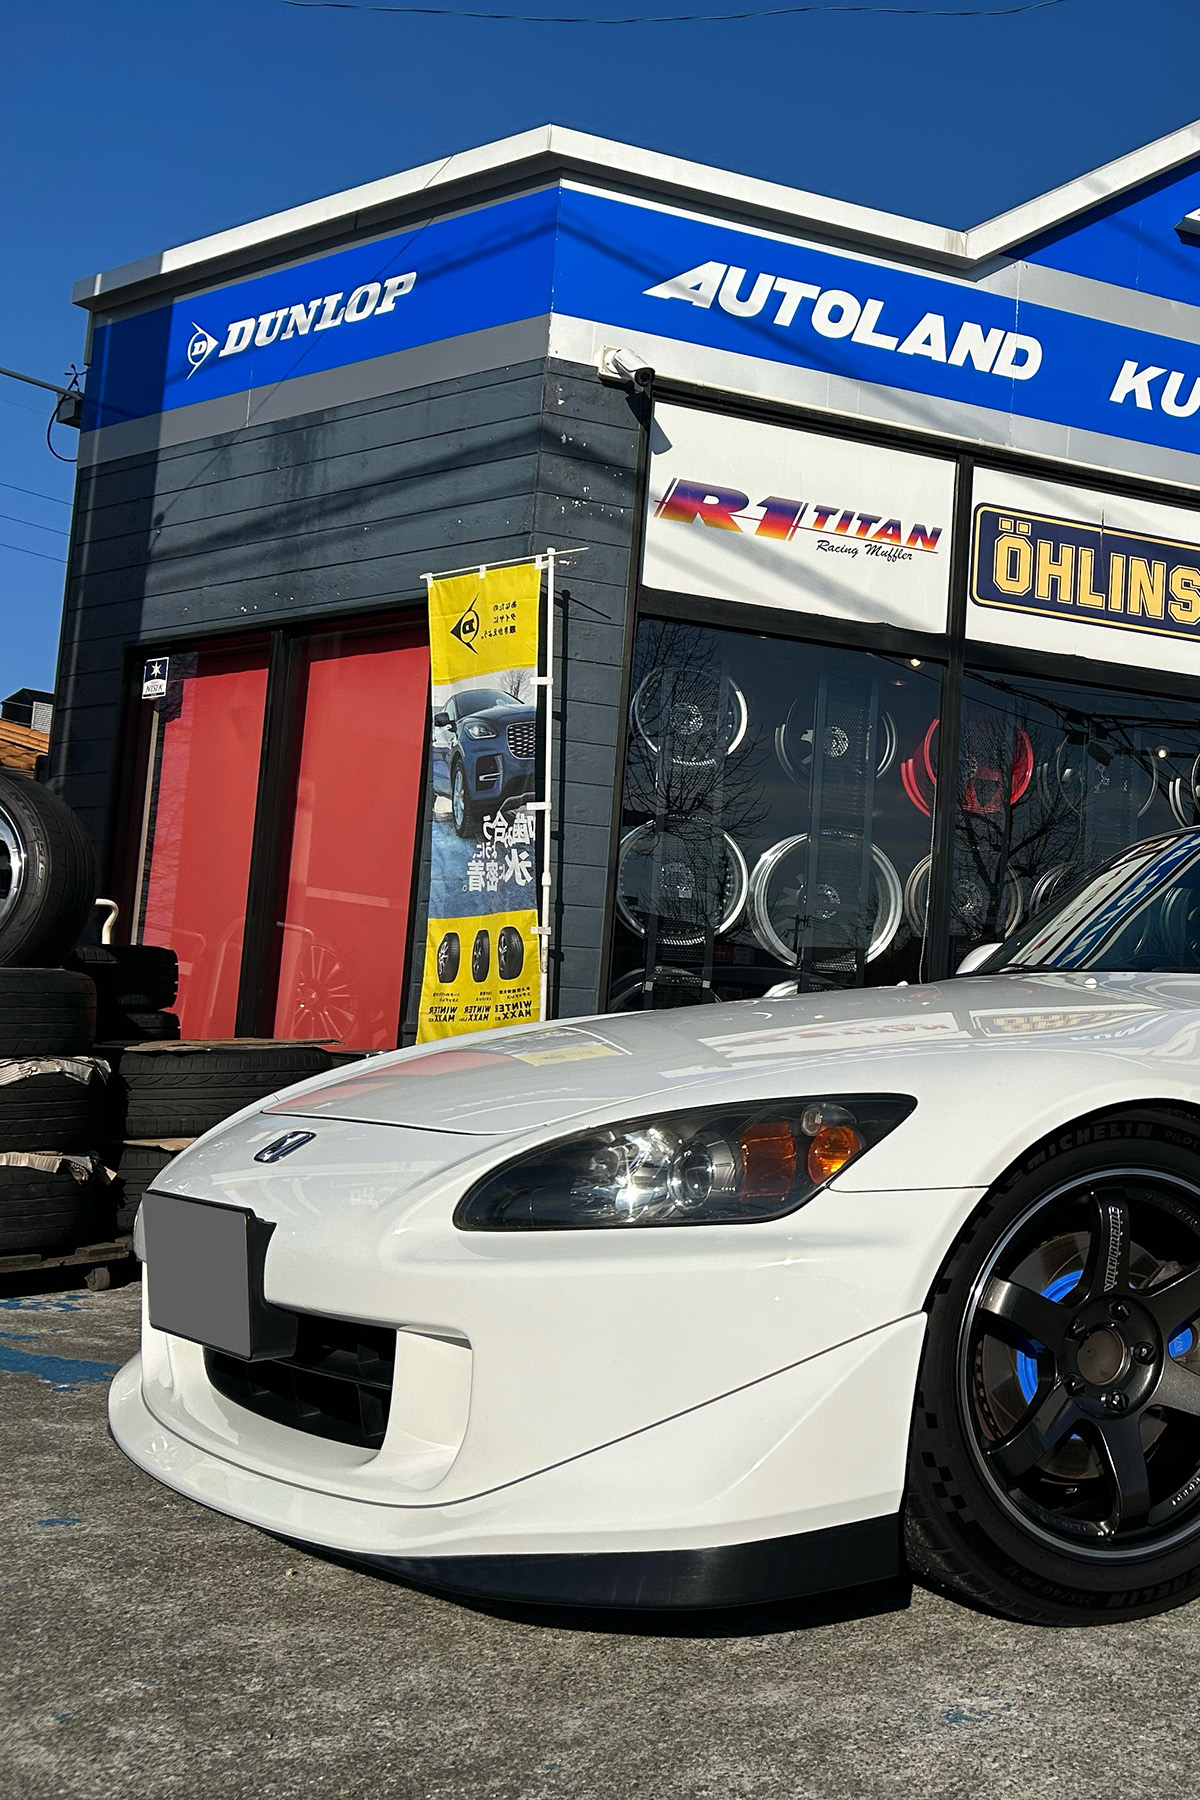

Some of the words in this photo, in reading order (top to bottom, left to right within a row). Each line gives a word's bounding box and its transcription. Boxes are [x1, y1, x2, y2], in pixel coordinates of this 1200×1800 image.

[218, 271, 417, 358] DUNLOP
[643, 259, 1042, 381] AUTOLAND
[658, 478, 804, 541] R1
[812, 504, 943, 550] TITAN
[816, 540, 860, 558] Racing
[864, 543, 913, 563] Muffler
[1026, 1122, 1153, 1170] MICHELIN
[1163, 1130, 1199, 1148] PILOT
